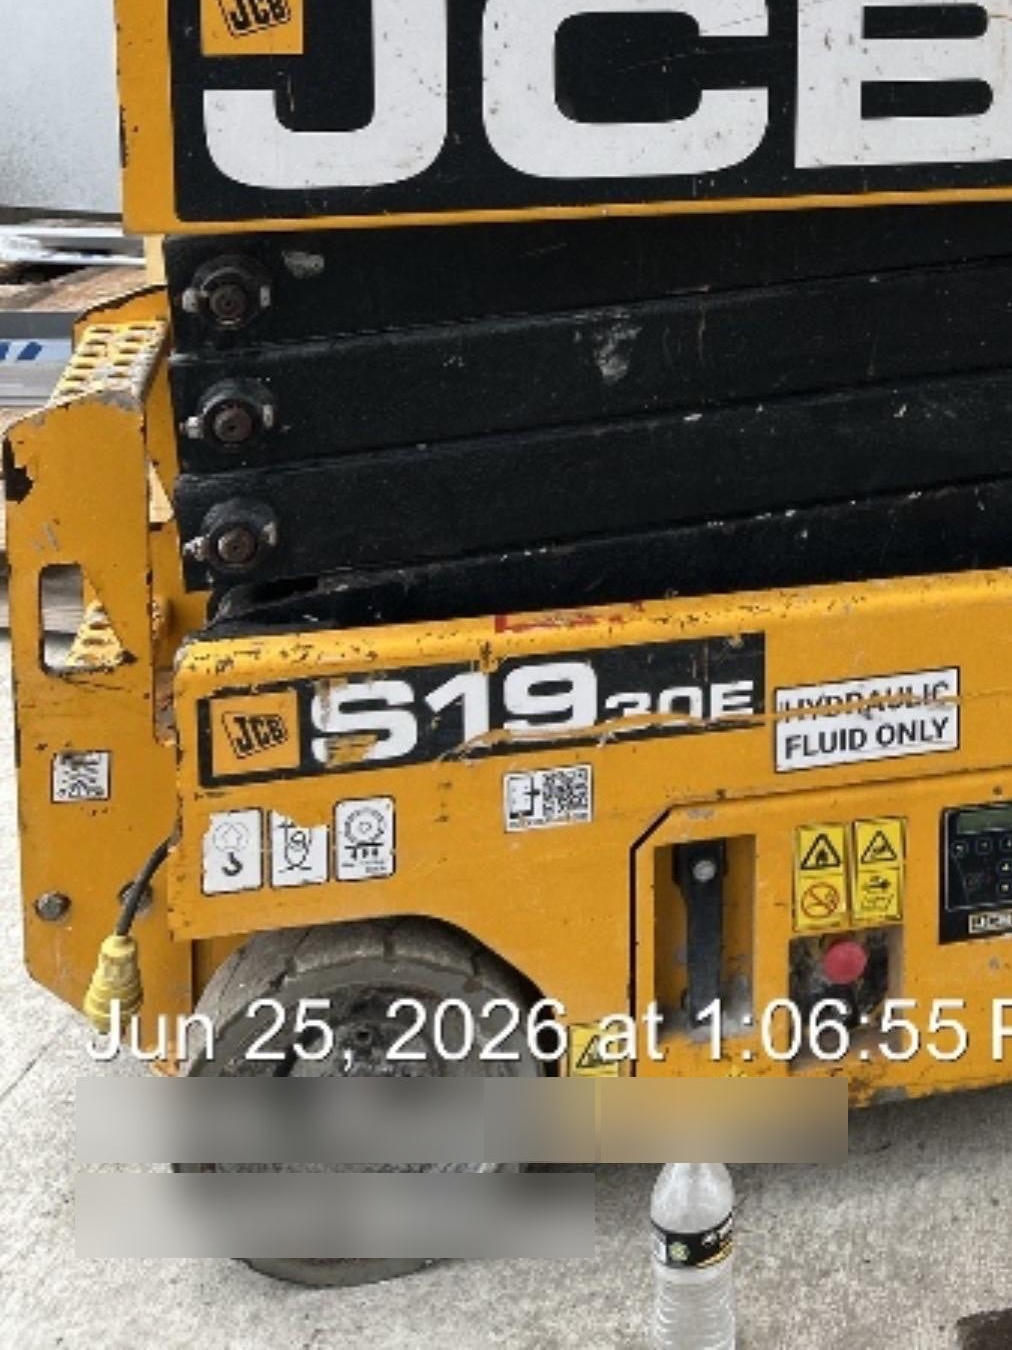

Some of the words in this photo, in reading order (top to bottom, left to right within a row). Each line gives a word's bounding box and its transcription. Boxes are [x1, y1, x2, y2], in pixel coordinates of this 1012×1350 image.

[233, 713, 288, 752] JCB
[785, 727, 868, 760] FLUID
[876, 716, 949, 747] ONLY
